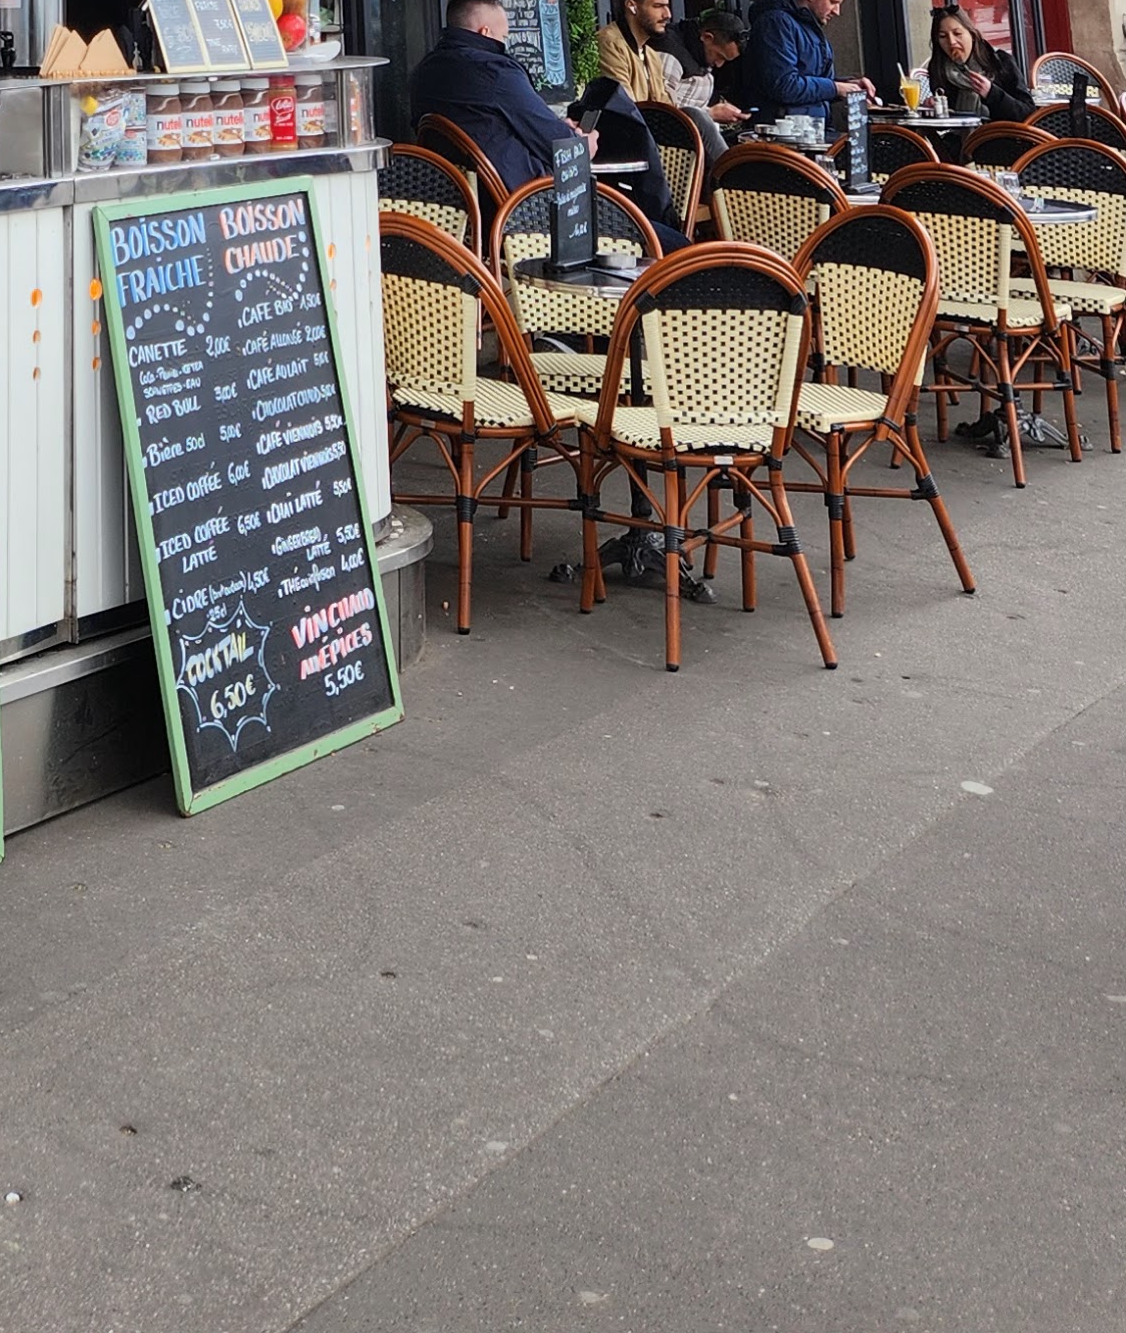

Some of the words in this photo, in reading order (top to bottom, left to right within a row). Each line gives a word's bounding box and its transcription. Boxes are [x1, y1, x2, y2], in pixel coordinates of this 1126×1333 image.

[218, 197, 306, 241] BOISSON
[109, 213, 207, 267] BOISSON
[224, 234, 301, 275] CHAUDE
[129, 338, 188, 368] CANETTE
[205, 335, 231, 359] 2,00€
[145, 404, 172, 425] RED
[172, 395, 202, 417] BULL
[146, 436, 185, 468] Bière
[153, 486, 185, 514] ICED
[158, 532, 192, 560] ICED
[185, 631, 255, 687] COCKTAIL
[210, 673, 257, 719] 6,50€
[324, 660, 366, 697] 5,50€
